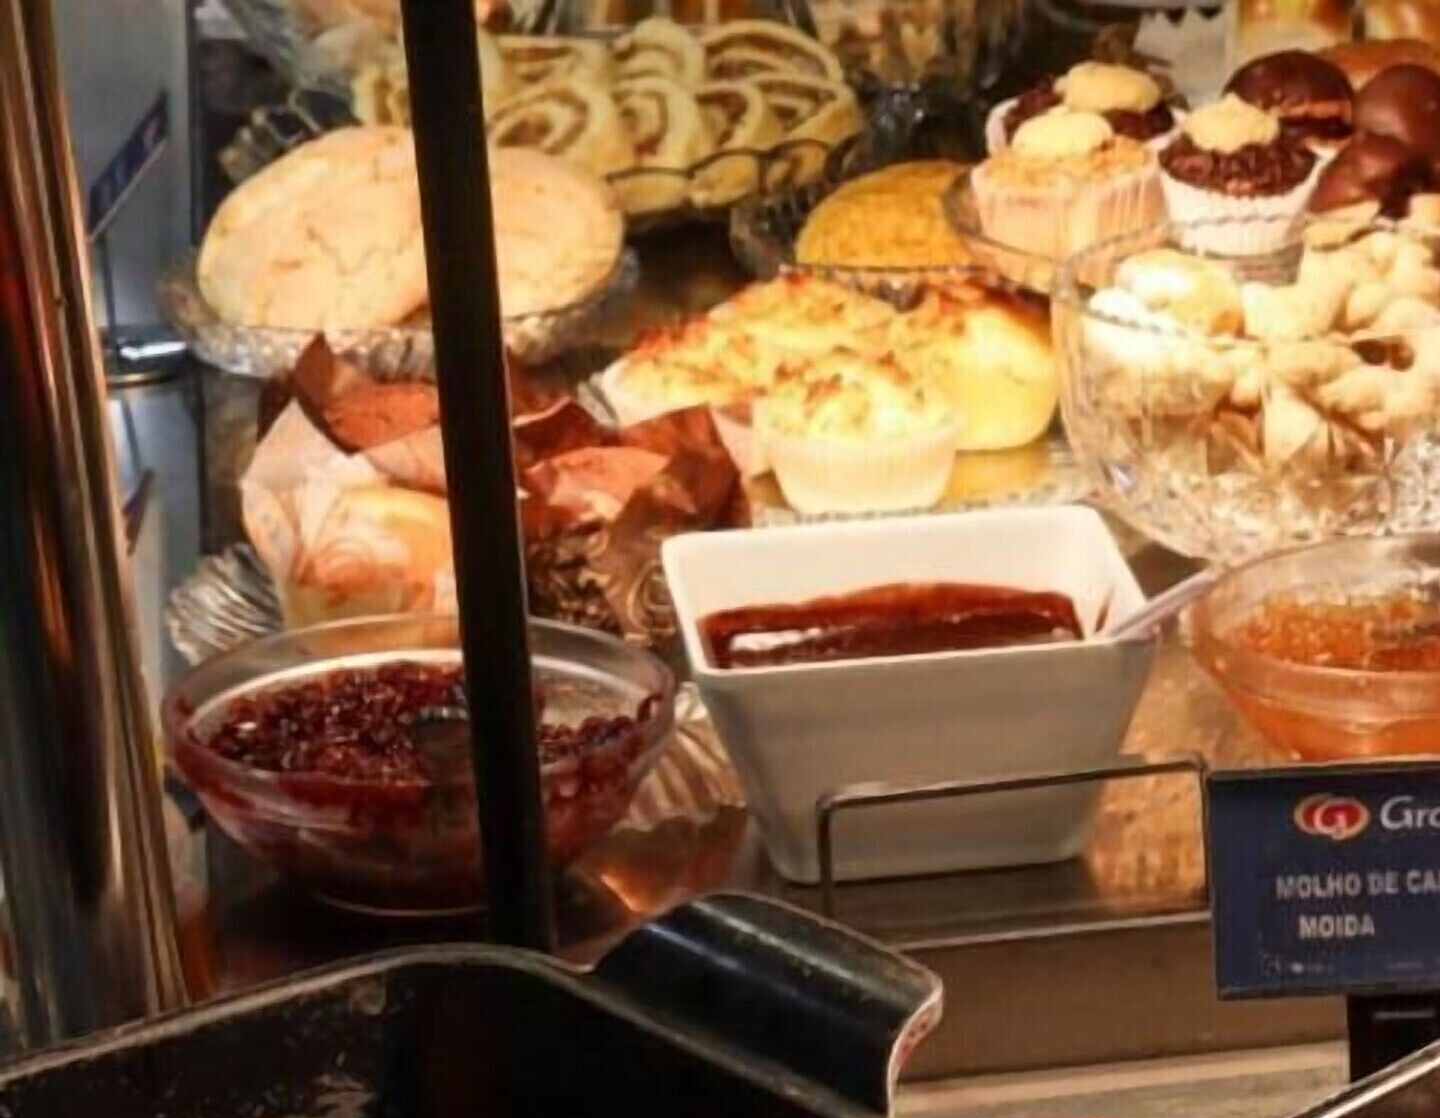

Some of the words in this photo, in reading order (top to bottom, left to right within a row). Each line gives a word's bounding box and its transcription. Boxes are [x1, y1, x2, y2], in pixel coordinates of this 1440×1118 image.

[1276, 872, 1361, 899] MOLHO
[1368, 870, 1398, 893] DE
[1299, 914, 1375, 938] MOIDA
